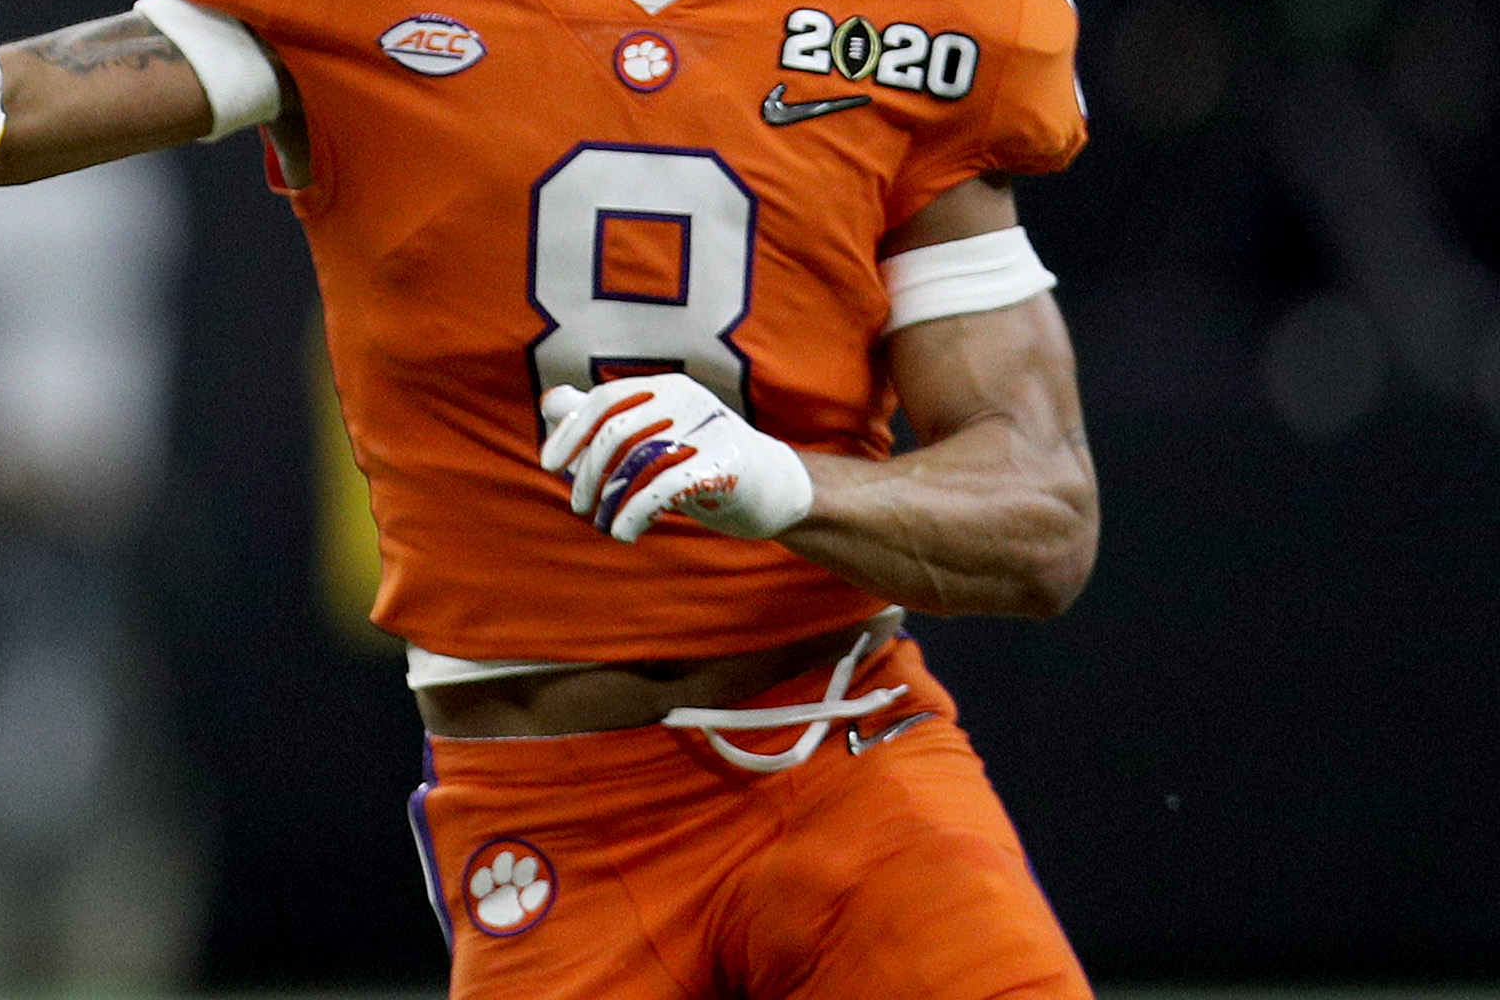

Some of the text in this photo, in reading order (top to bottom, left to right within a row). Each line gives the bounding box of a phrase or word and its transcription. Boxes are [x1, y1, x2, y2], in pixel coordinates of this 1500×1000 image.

[392, 28, 473, 54] ACC
[779, 6, 981, 101] 2020
[527, 139, 759, 445] 8
